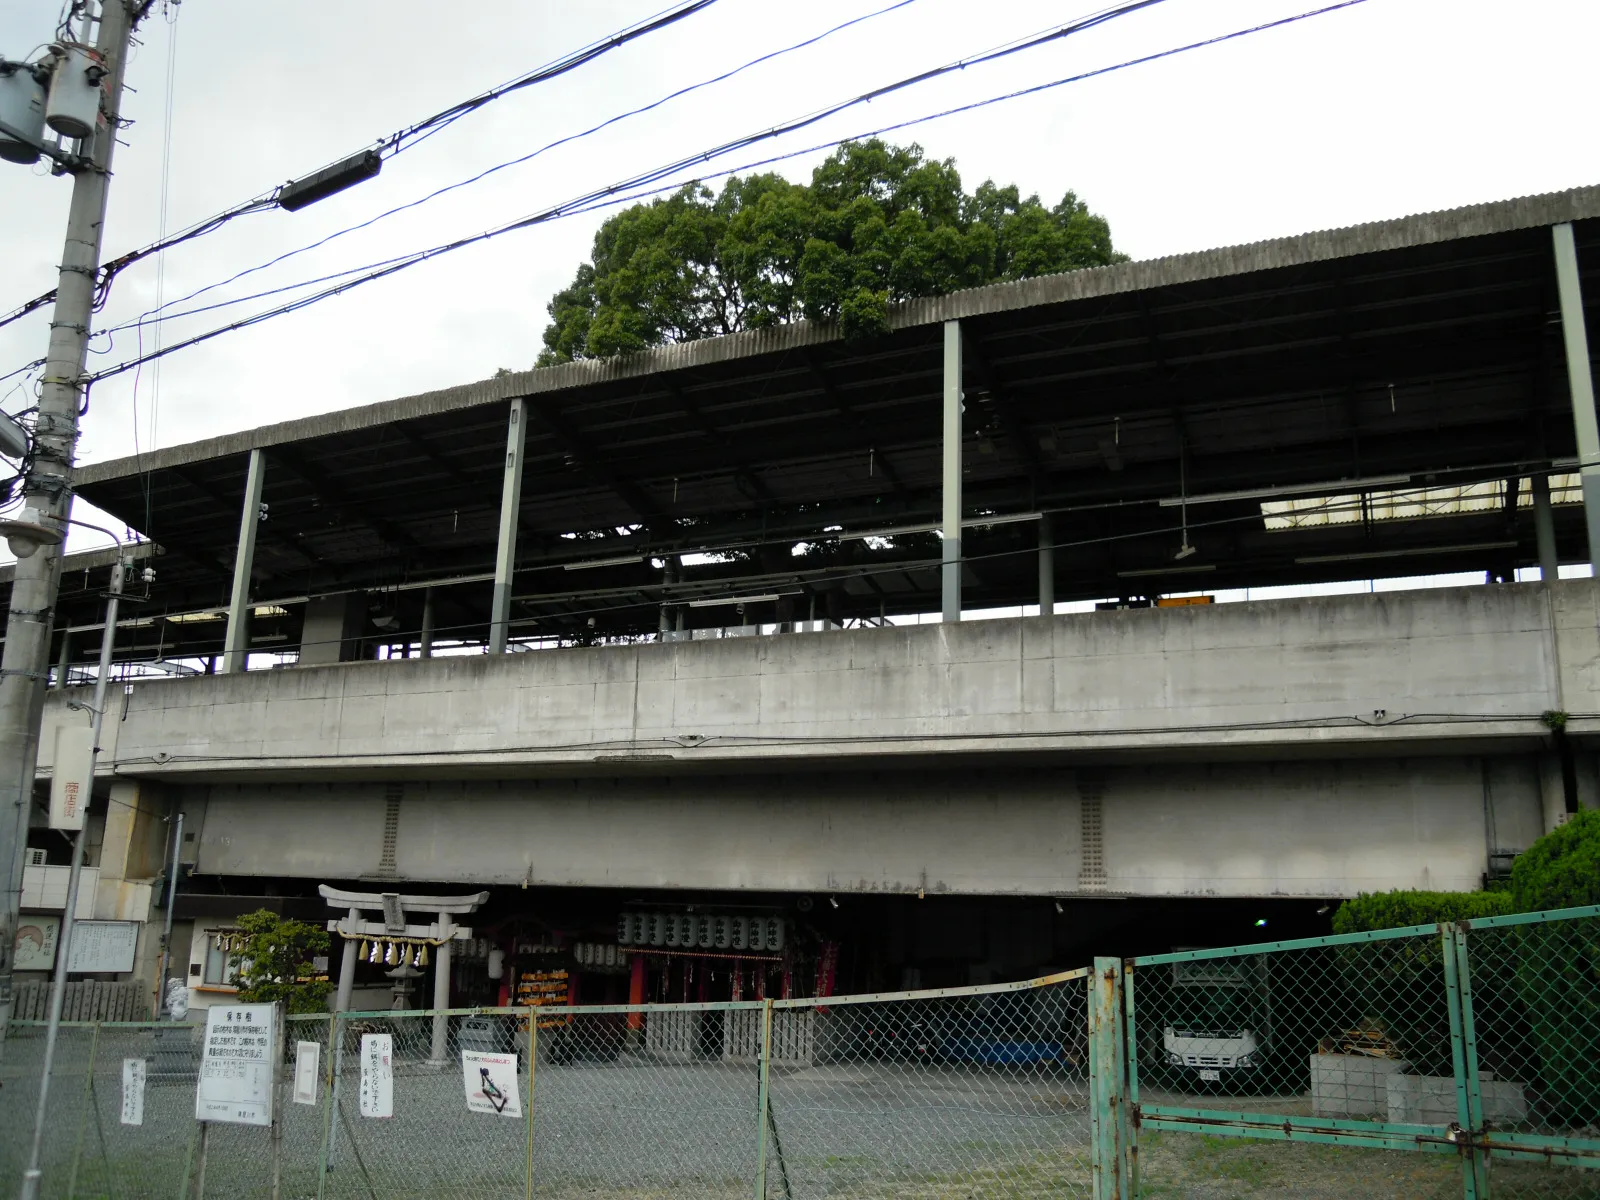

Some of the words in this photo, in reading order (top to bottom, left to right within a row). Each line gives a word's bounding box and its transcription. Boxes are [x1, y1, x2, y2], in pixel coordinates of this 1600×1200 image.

[64, 782, 79, 818] 商店街
[226, 1011, 252, 1022] 保存樹
[382, 1041, 391, 1080] お願い
